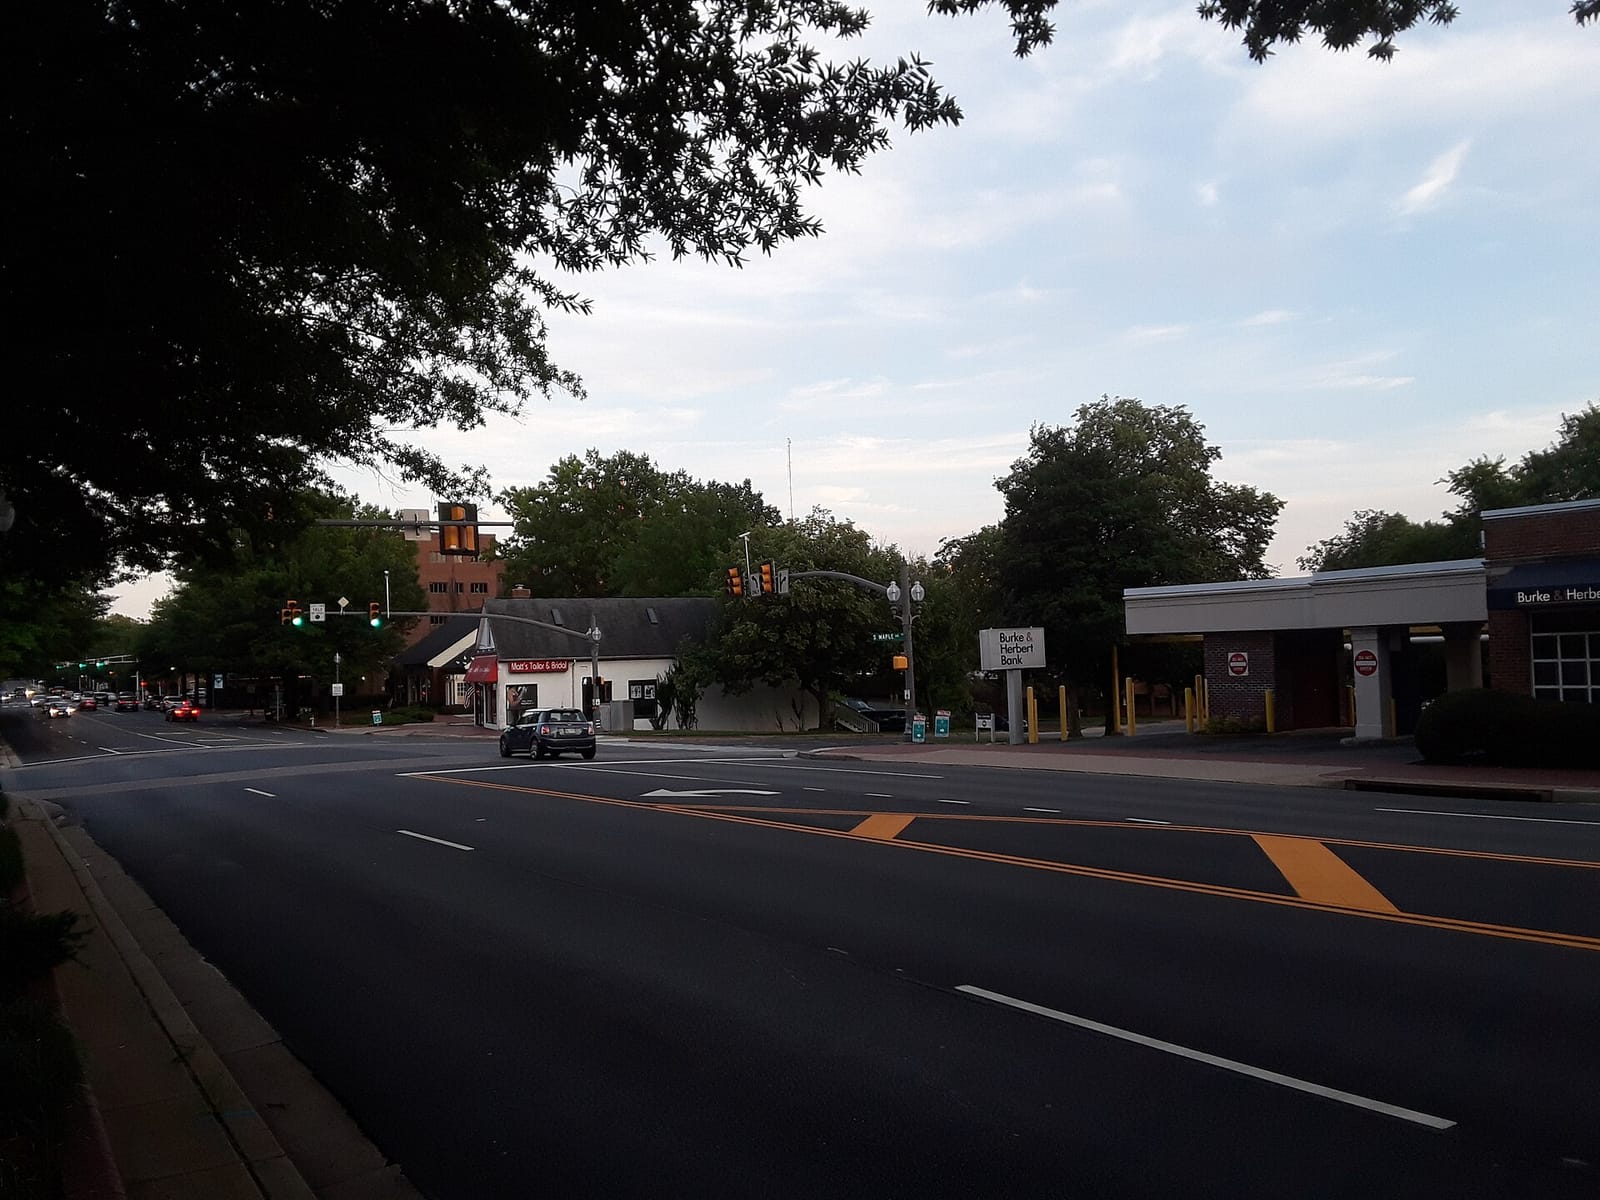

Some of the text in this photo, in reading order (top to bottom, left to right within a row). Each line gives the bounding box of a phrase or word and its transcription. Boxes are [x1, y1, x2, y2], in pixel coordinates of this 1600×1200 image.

[1518, 590, 1550, 602] Burke
[1000, 632, 1032, 642] Burke &
[1000, 643, 1033, 654] Herbert
[1001, 654, 1022, 665] Bank
